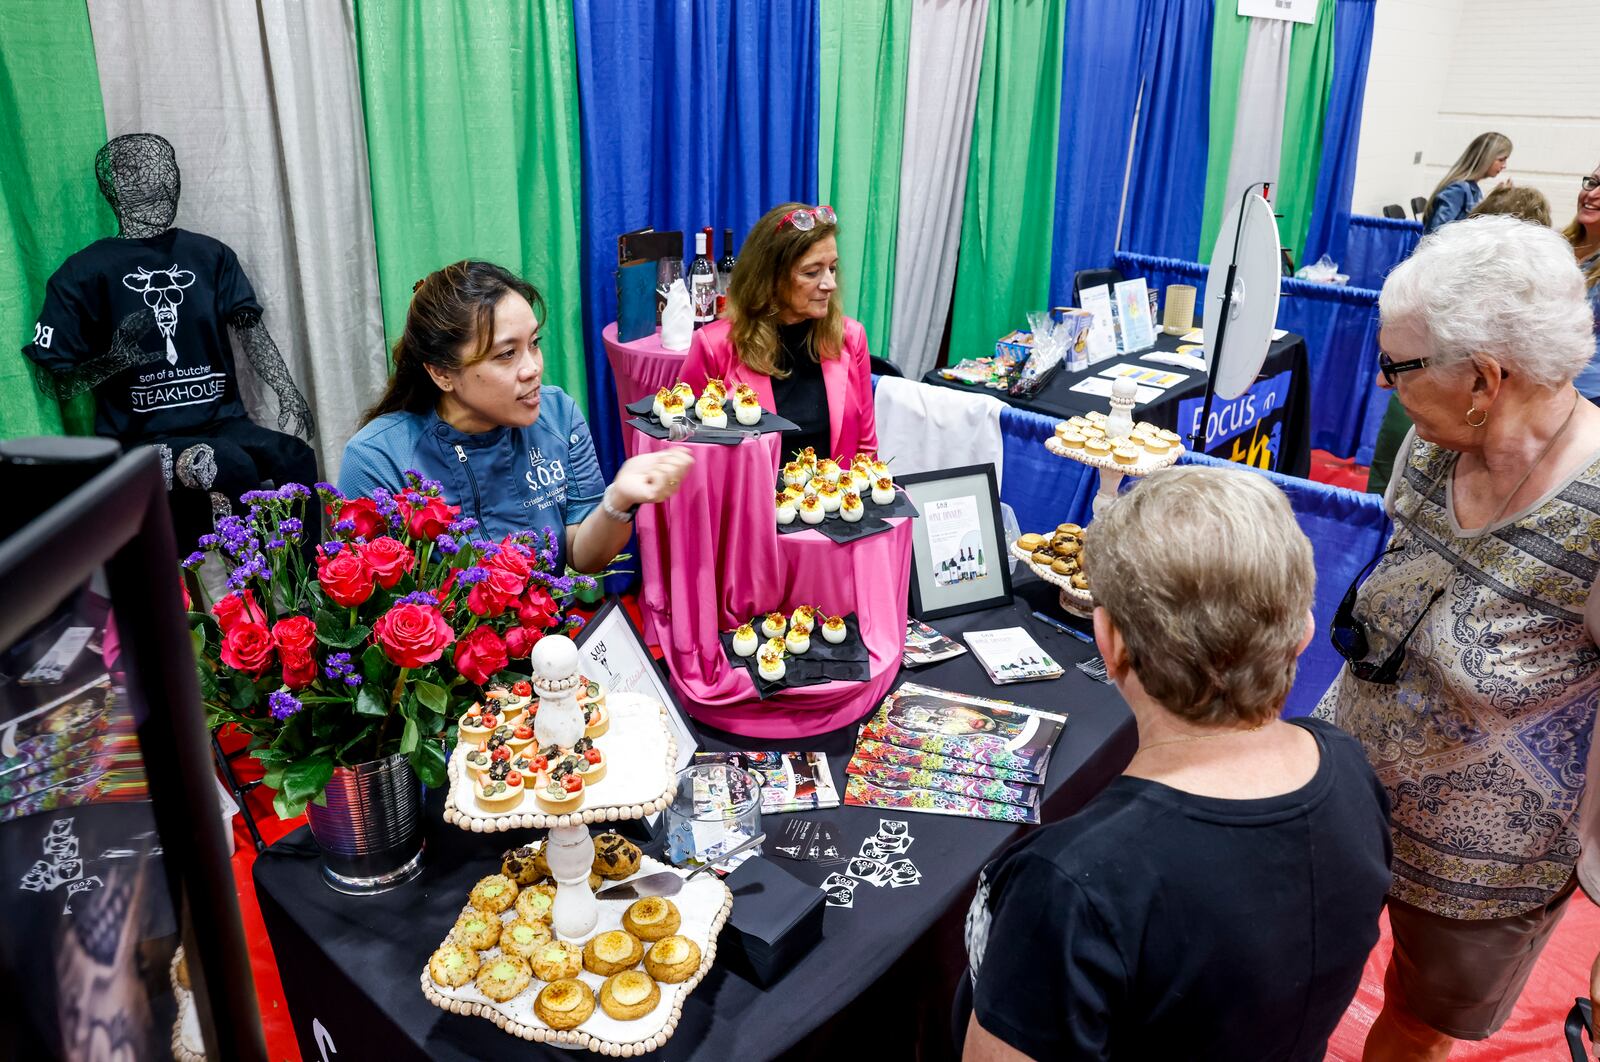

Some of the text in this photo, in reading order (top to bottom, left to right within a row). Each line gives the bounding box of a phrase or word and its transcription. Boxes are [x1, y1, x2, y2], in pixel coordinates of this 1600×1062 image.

[139, 364, 212, 383] son of a butcher
[131, 380, 227, 406] STEAKHOUSE
